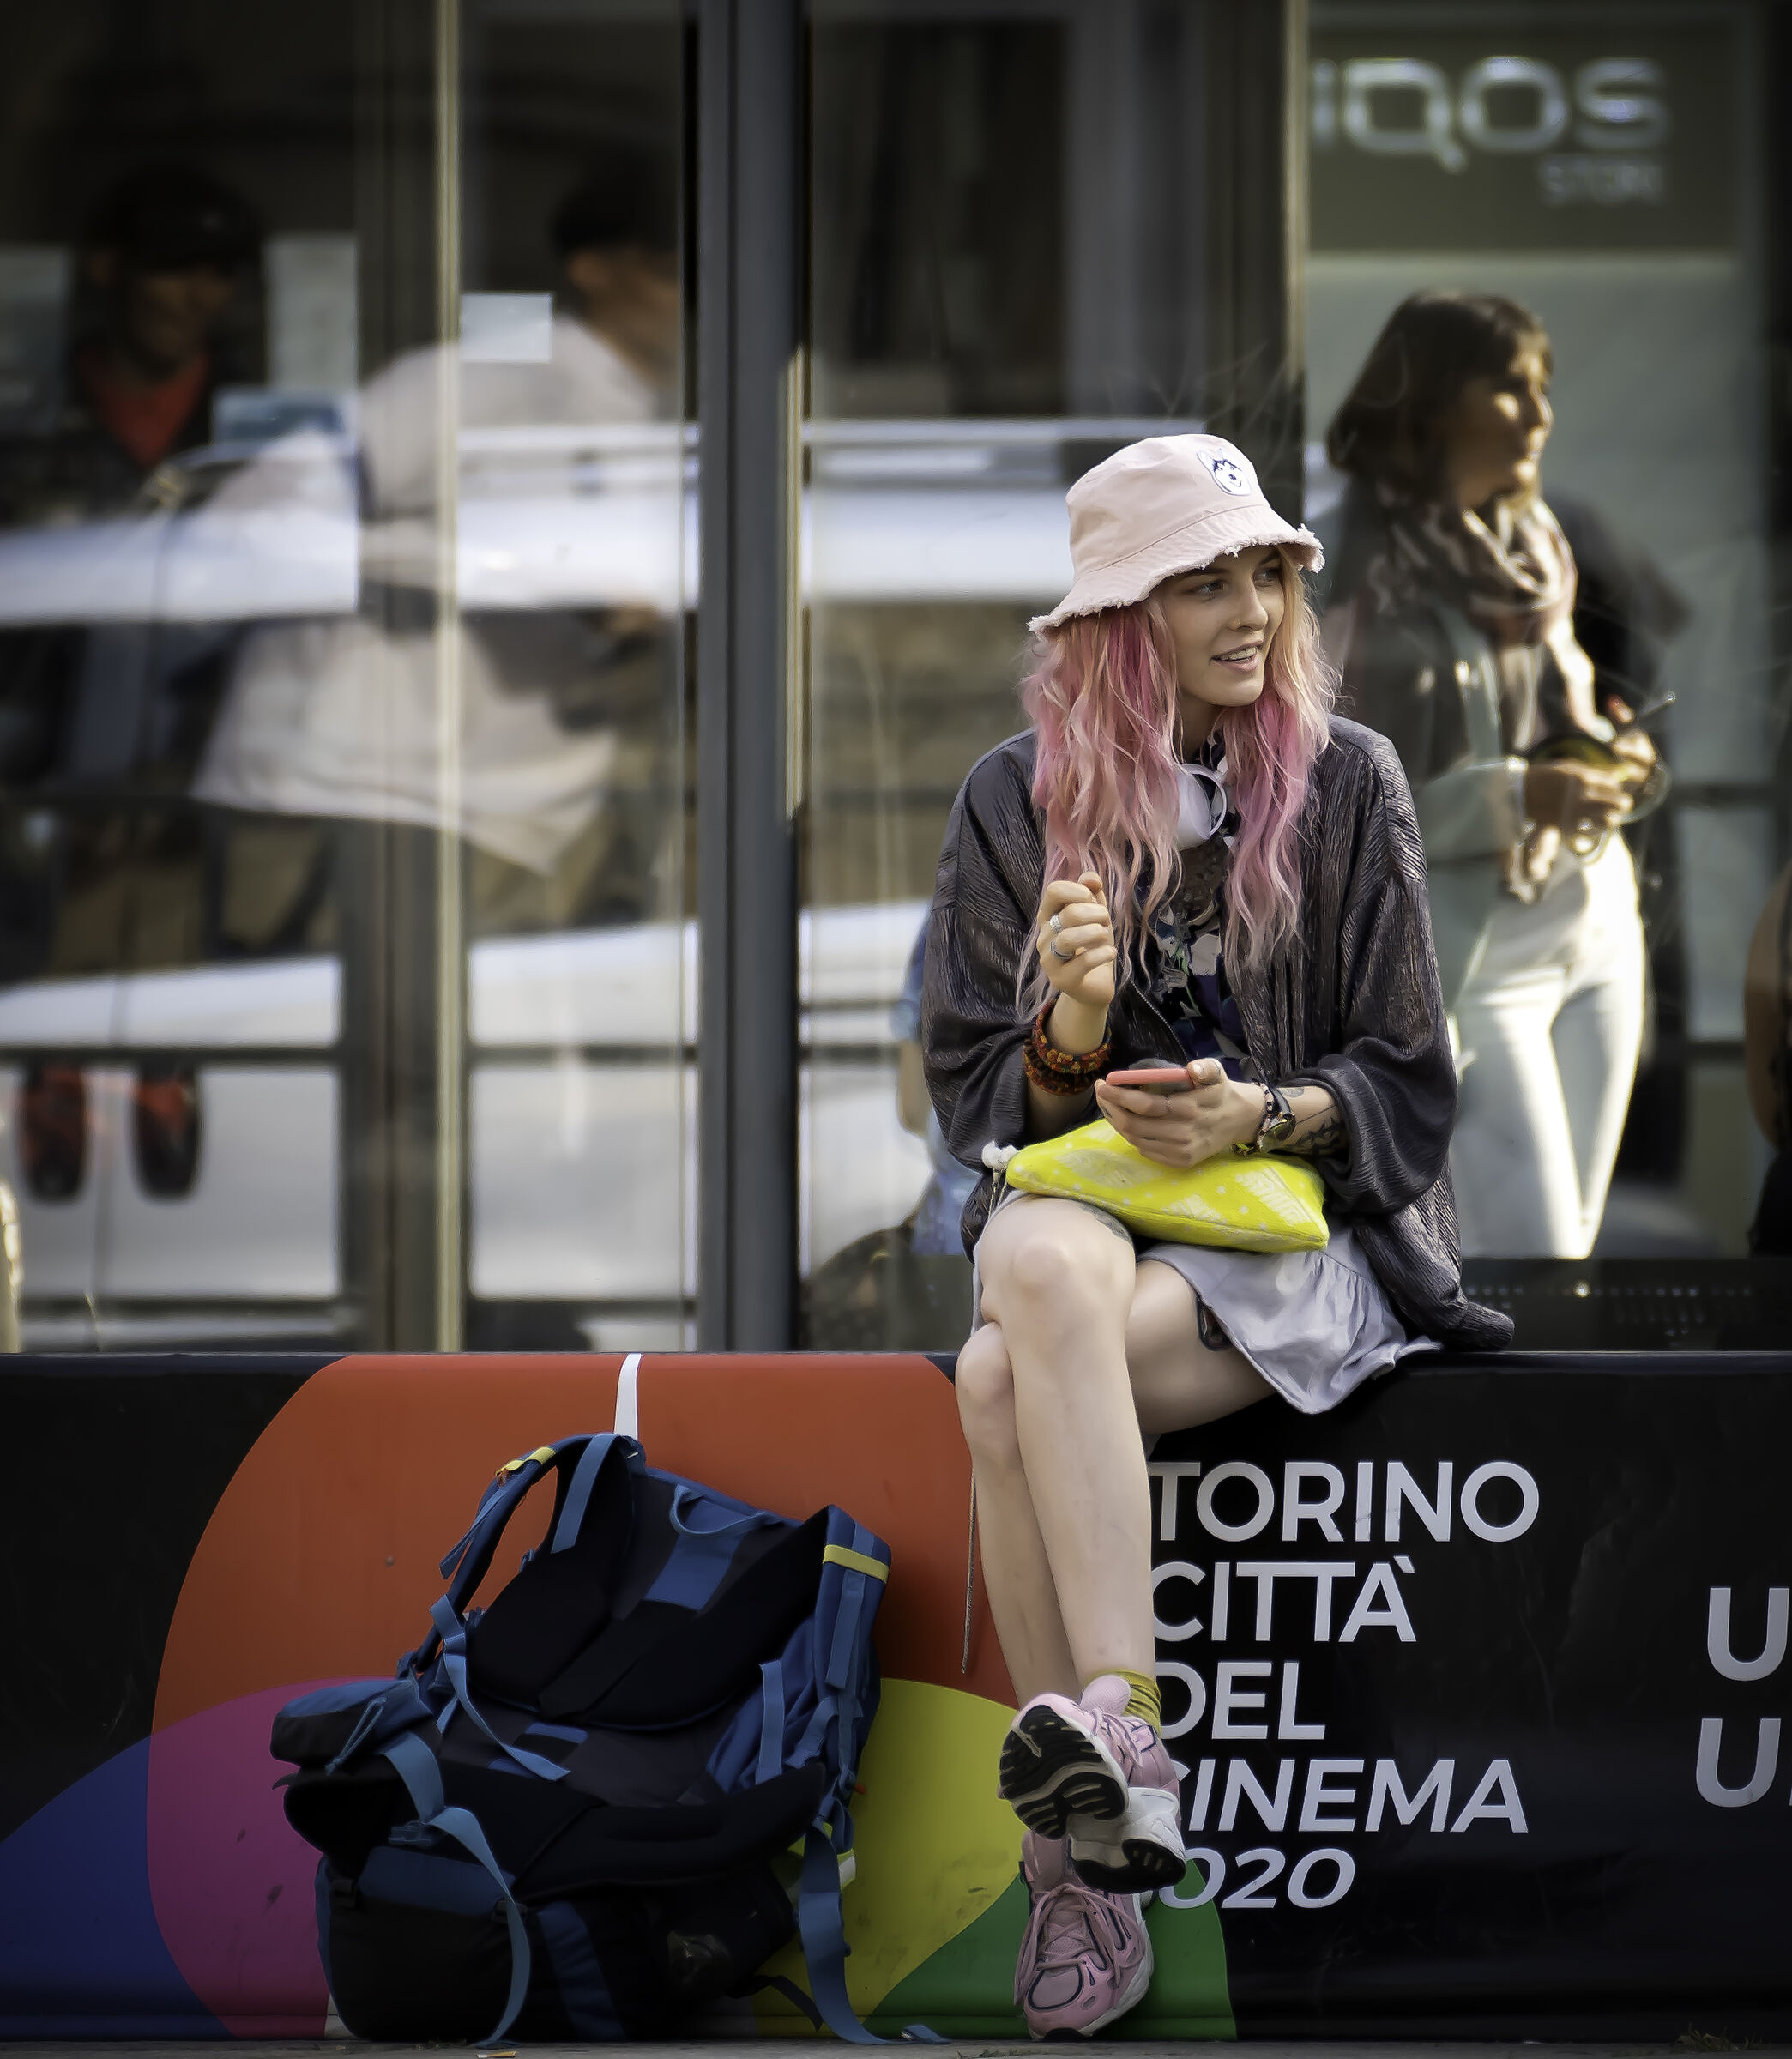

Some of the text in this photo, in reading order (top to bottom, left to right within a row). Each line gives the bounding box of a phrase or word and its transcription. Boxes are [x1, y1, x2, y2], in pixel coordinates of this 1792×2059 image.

[1149, 1460, 1540, 1542] TORINO
[1151, 1555, 1417, 1642] CITTÀ
[1155, 1661, 1326, 1740] DEL
[1175, 1759, 1529, 1833] INEMA
[1695, 1718, 1792, 1808] U
[1158, 1847, 1356, 1909] 020
